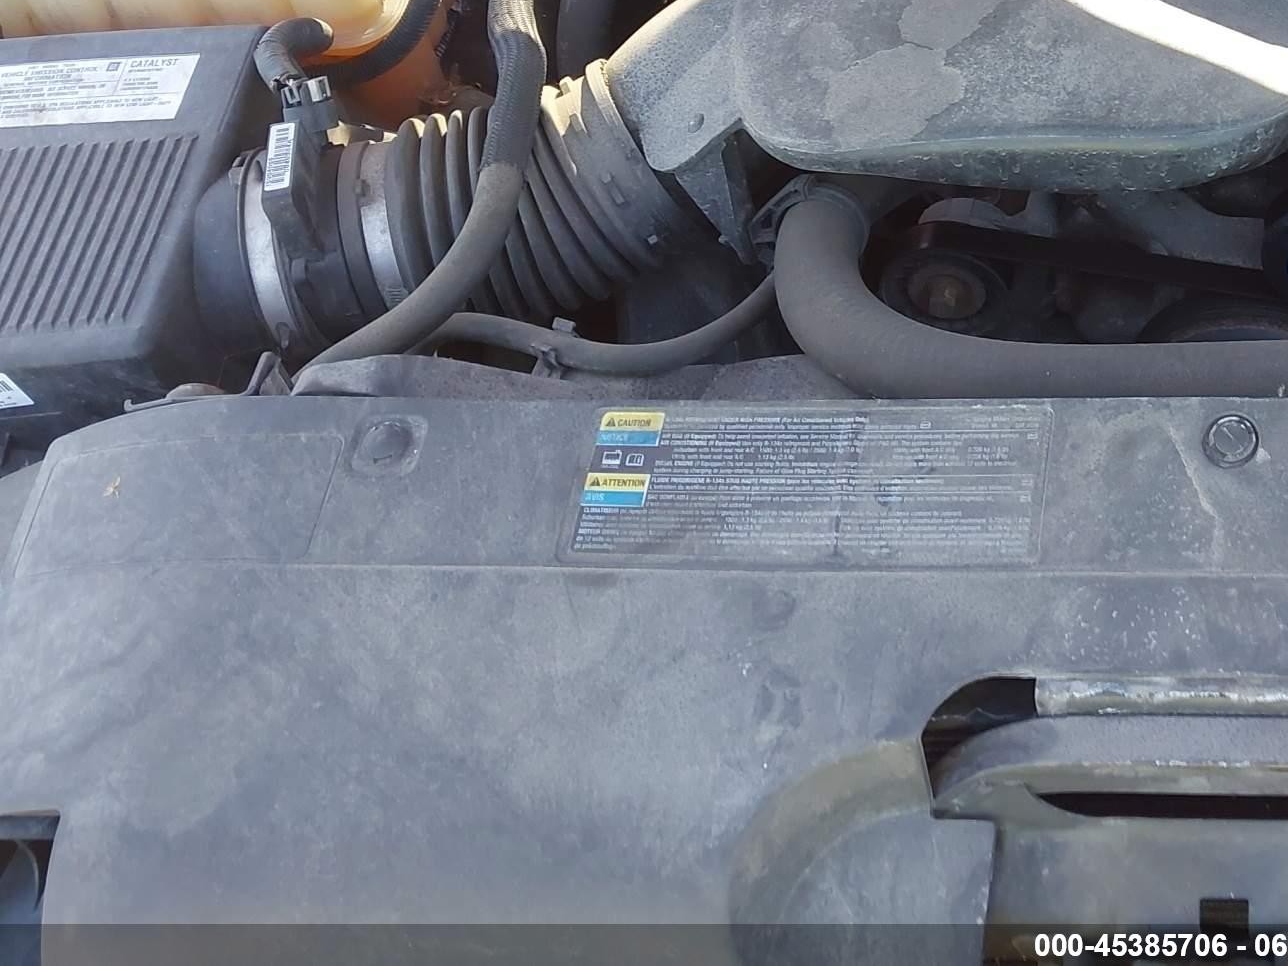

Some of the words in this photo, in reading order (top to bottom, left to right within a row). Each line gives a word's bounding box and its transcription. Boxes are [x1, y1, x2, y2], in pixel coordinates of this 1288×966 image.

[130, 58, 179, 68] CATALYST
[617, 418, 652, 427] CAUTION
[602, 479, 646, 487] ATTENTION
